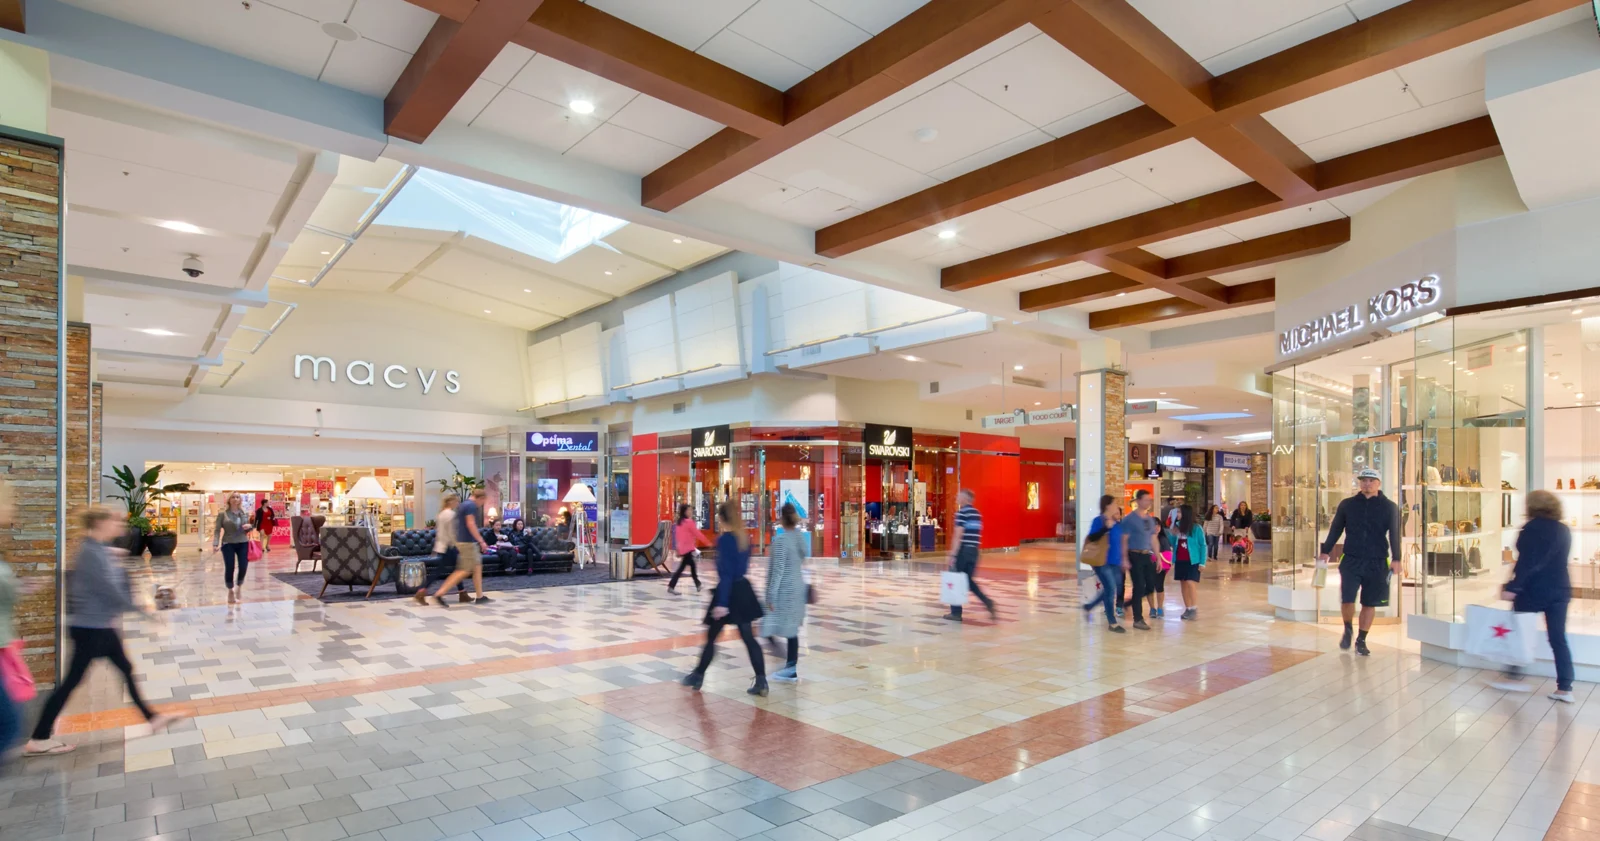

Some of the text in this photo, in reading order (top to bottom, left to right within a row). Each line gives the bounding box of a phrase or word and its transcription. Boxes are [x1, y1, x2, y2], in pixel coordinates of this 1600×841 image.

[1279, 274, 1441, 354] MICHAEL KORS
[294, 354, 461, 395] macys
[993, 417, 1015, 425] TARGET
[531, 432, 573, 447] Optima
[557, 440, 594, 452] Dental
[693, 446, 727, 458] SWAROVSKI
[869, 445, 910, 457] SWAROVSKI
